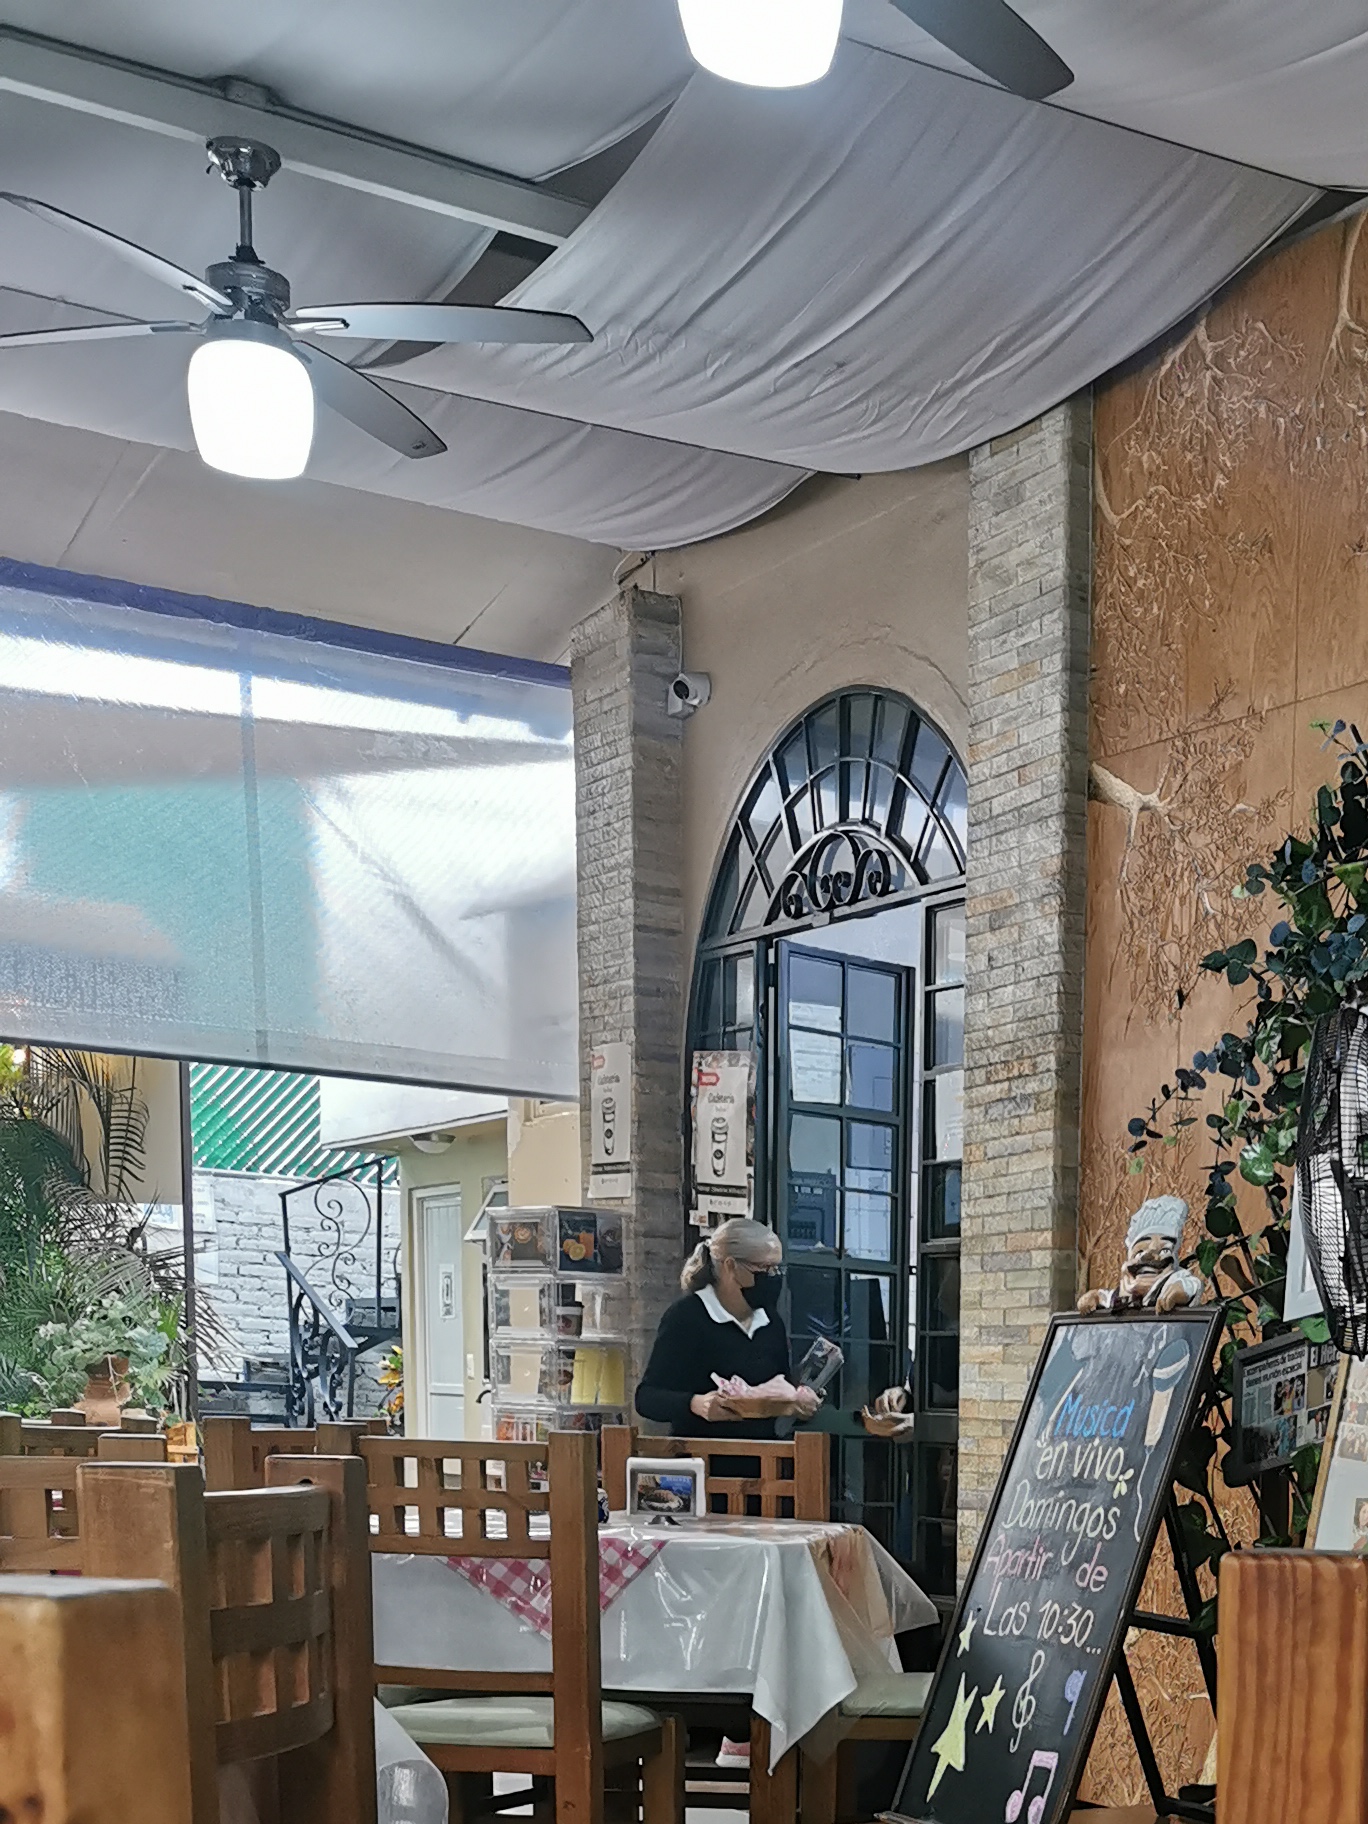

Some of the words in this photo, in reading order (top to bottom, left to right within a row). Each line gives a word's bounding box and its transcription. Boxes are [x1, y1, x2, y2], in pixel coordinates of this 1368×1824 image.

[1036, 1440, 1069, 1480] en
[1073, 1438, 1125, 1482] vivo
[1002, 1479, 1121, 1566] Domingos
[982, 1533, 1054, 1602] Apartir
[1075, 1541, 1109, 1592] de
[983, 1581, 1031, 1637] Las
